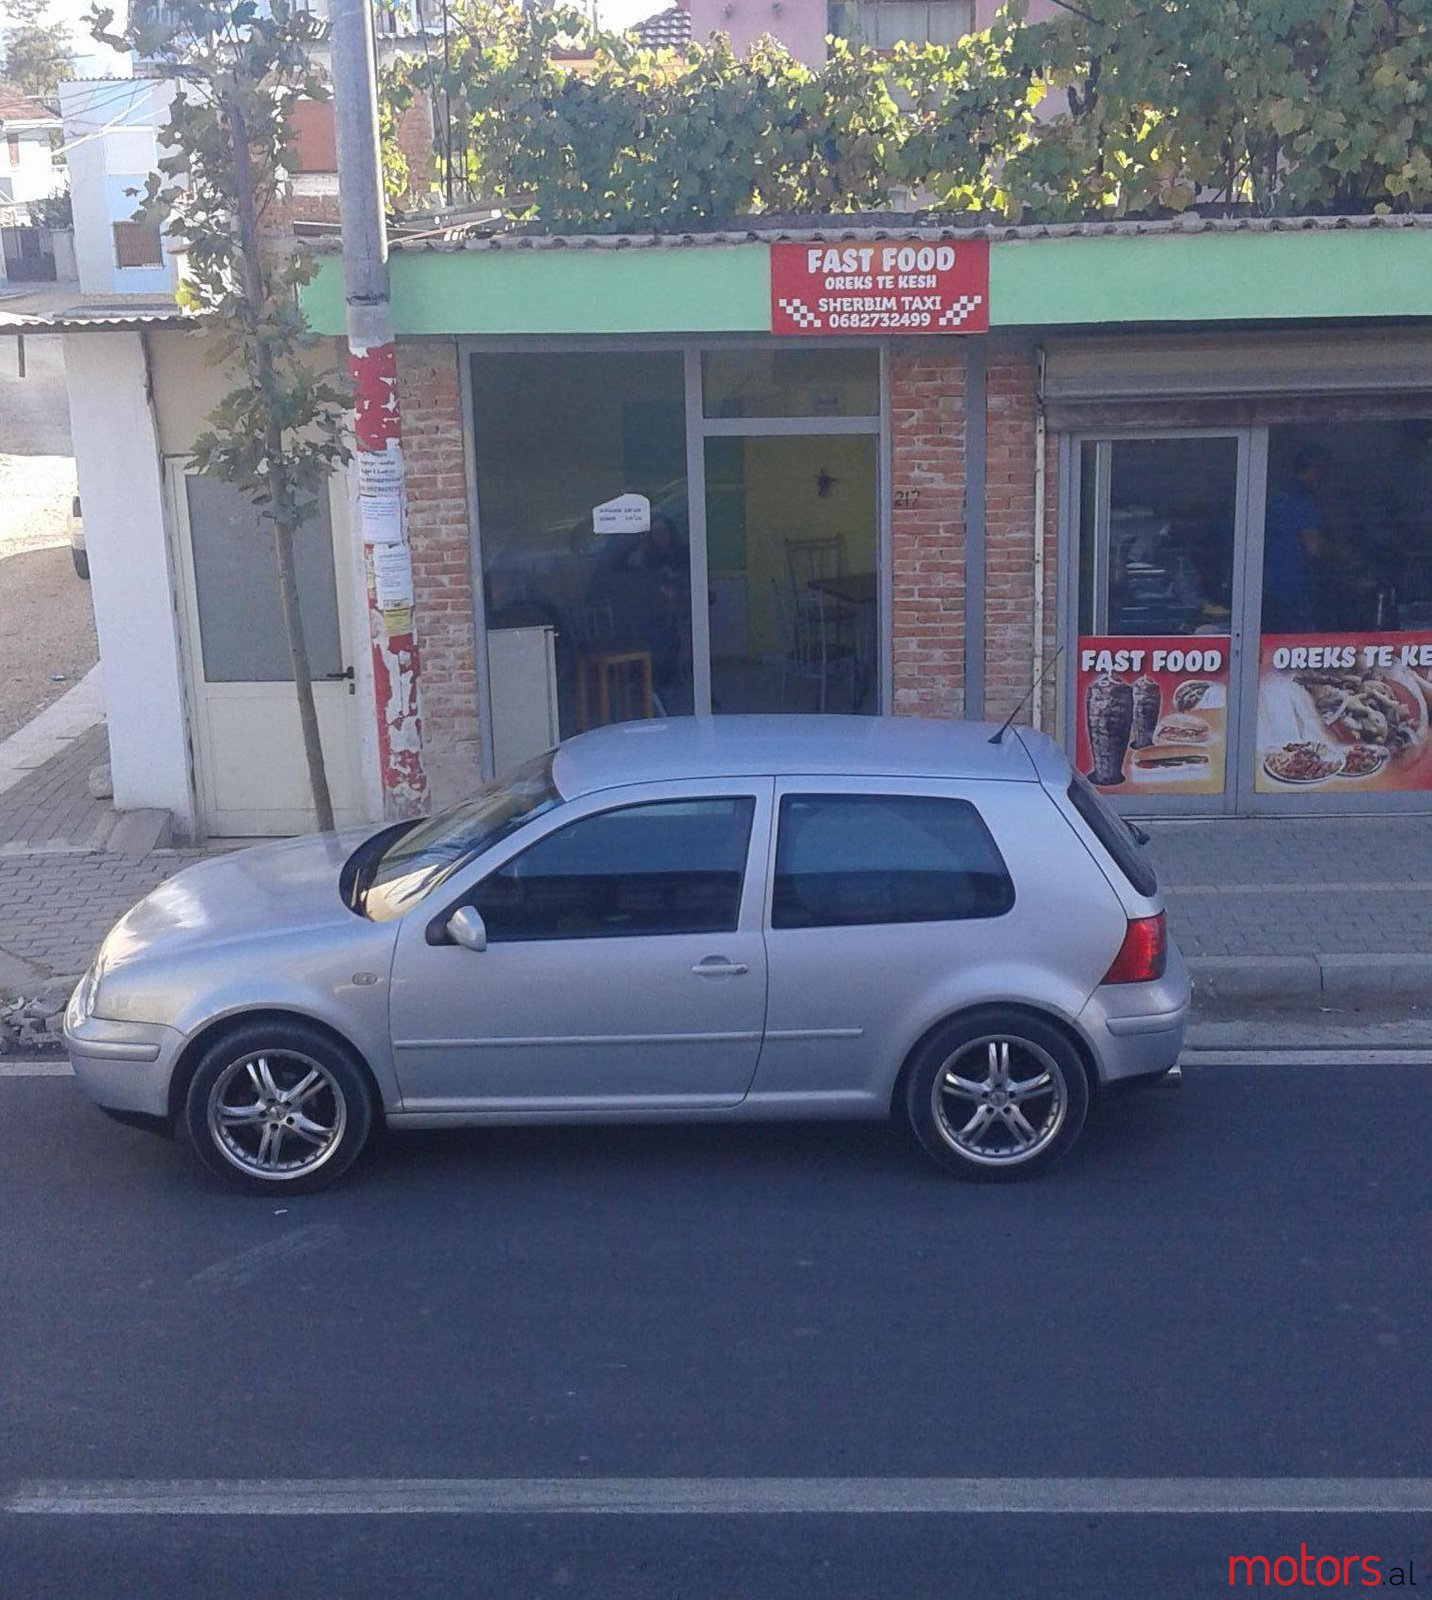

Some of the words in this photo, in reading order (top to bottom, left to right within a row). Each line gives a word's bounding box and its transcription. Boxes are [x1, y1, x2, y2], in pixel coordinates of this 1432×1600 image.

[807, 248, 874, 273] FAST
[881, 246, 956, 272] FOOD
[825, 276, 873, 290] OREKS
[876, 276, 894, 289] TE
[898, 274, 937, 289] KESH
[818, 297, 899, 312] SHERBIM
[901, 296, 942, 311] TAXI
[828, 312, 931, 328] 0682732499
[1081, 649, 1145, 672] FAST
[1152, 650, 1222, 673] FOOD
[1272, 646, 1356, 669] OREKS
[1362, 645, 1394, 667] TE
